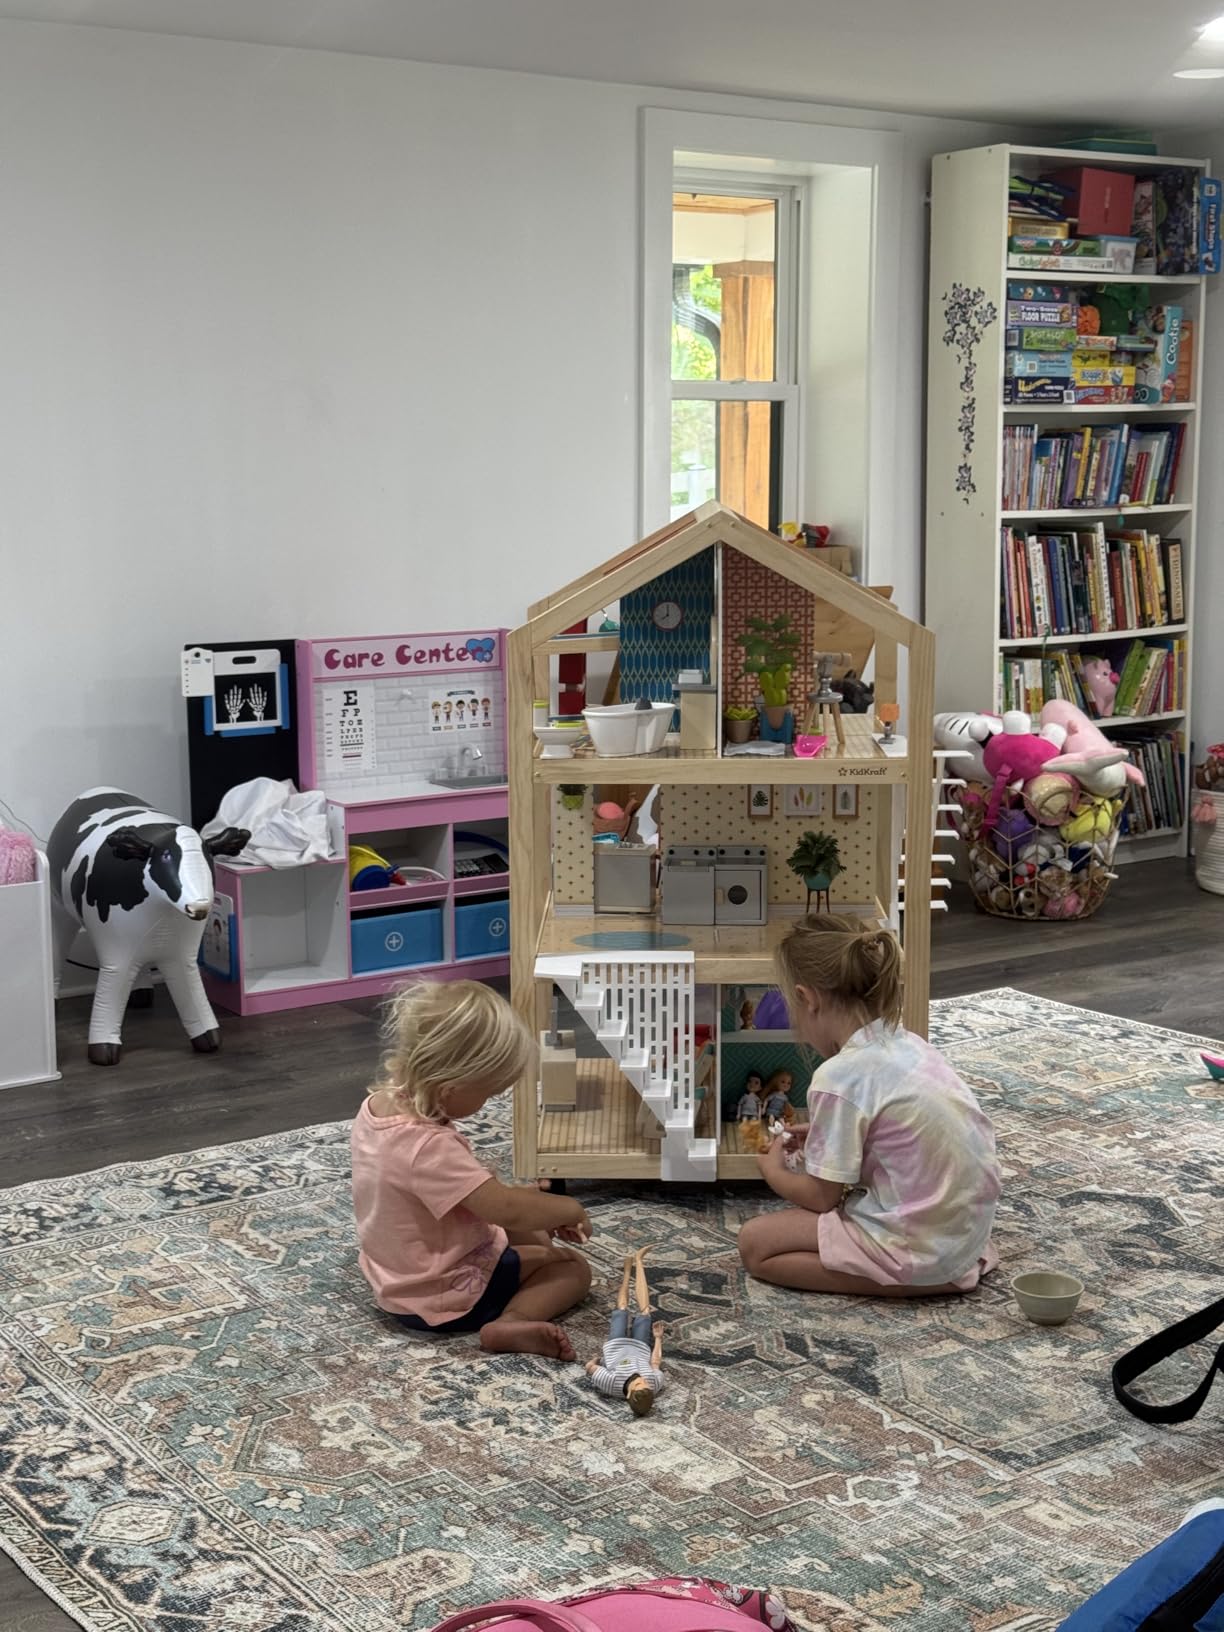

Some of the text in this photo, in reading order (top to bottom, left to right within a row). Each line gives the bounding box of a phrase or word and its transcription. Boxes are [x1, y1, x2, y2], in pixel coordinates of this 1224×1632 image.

[1166, 318, 1178, 365] Cootie
[324, 647, 386, 670] Care
[343, 690, 358, 707] E
[849, 767, 887, 776] KidKraft
